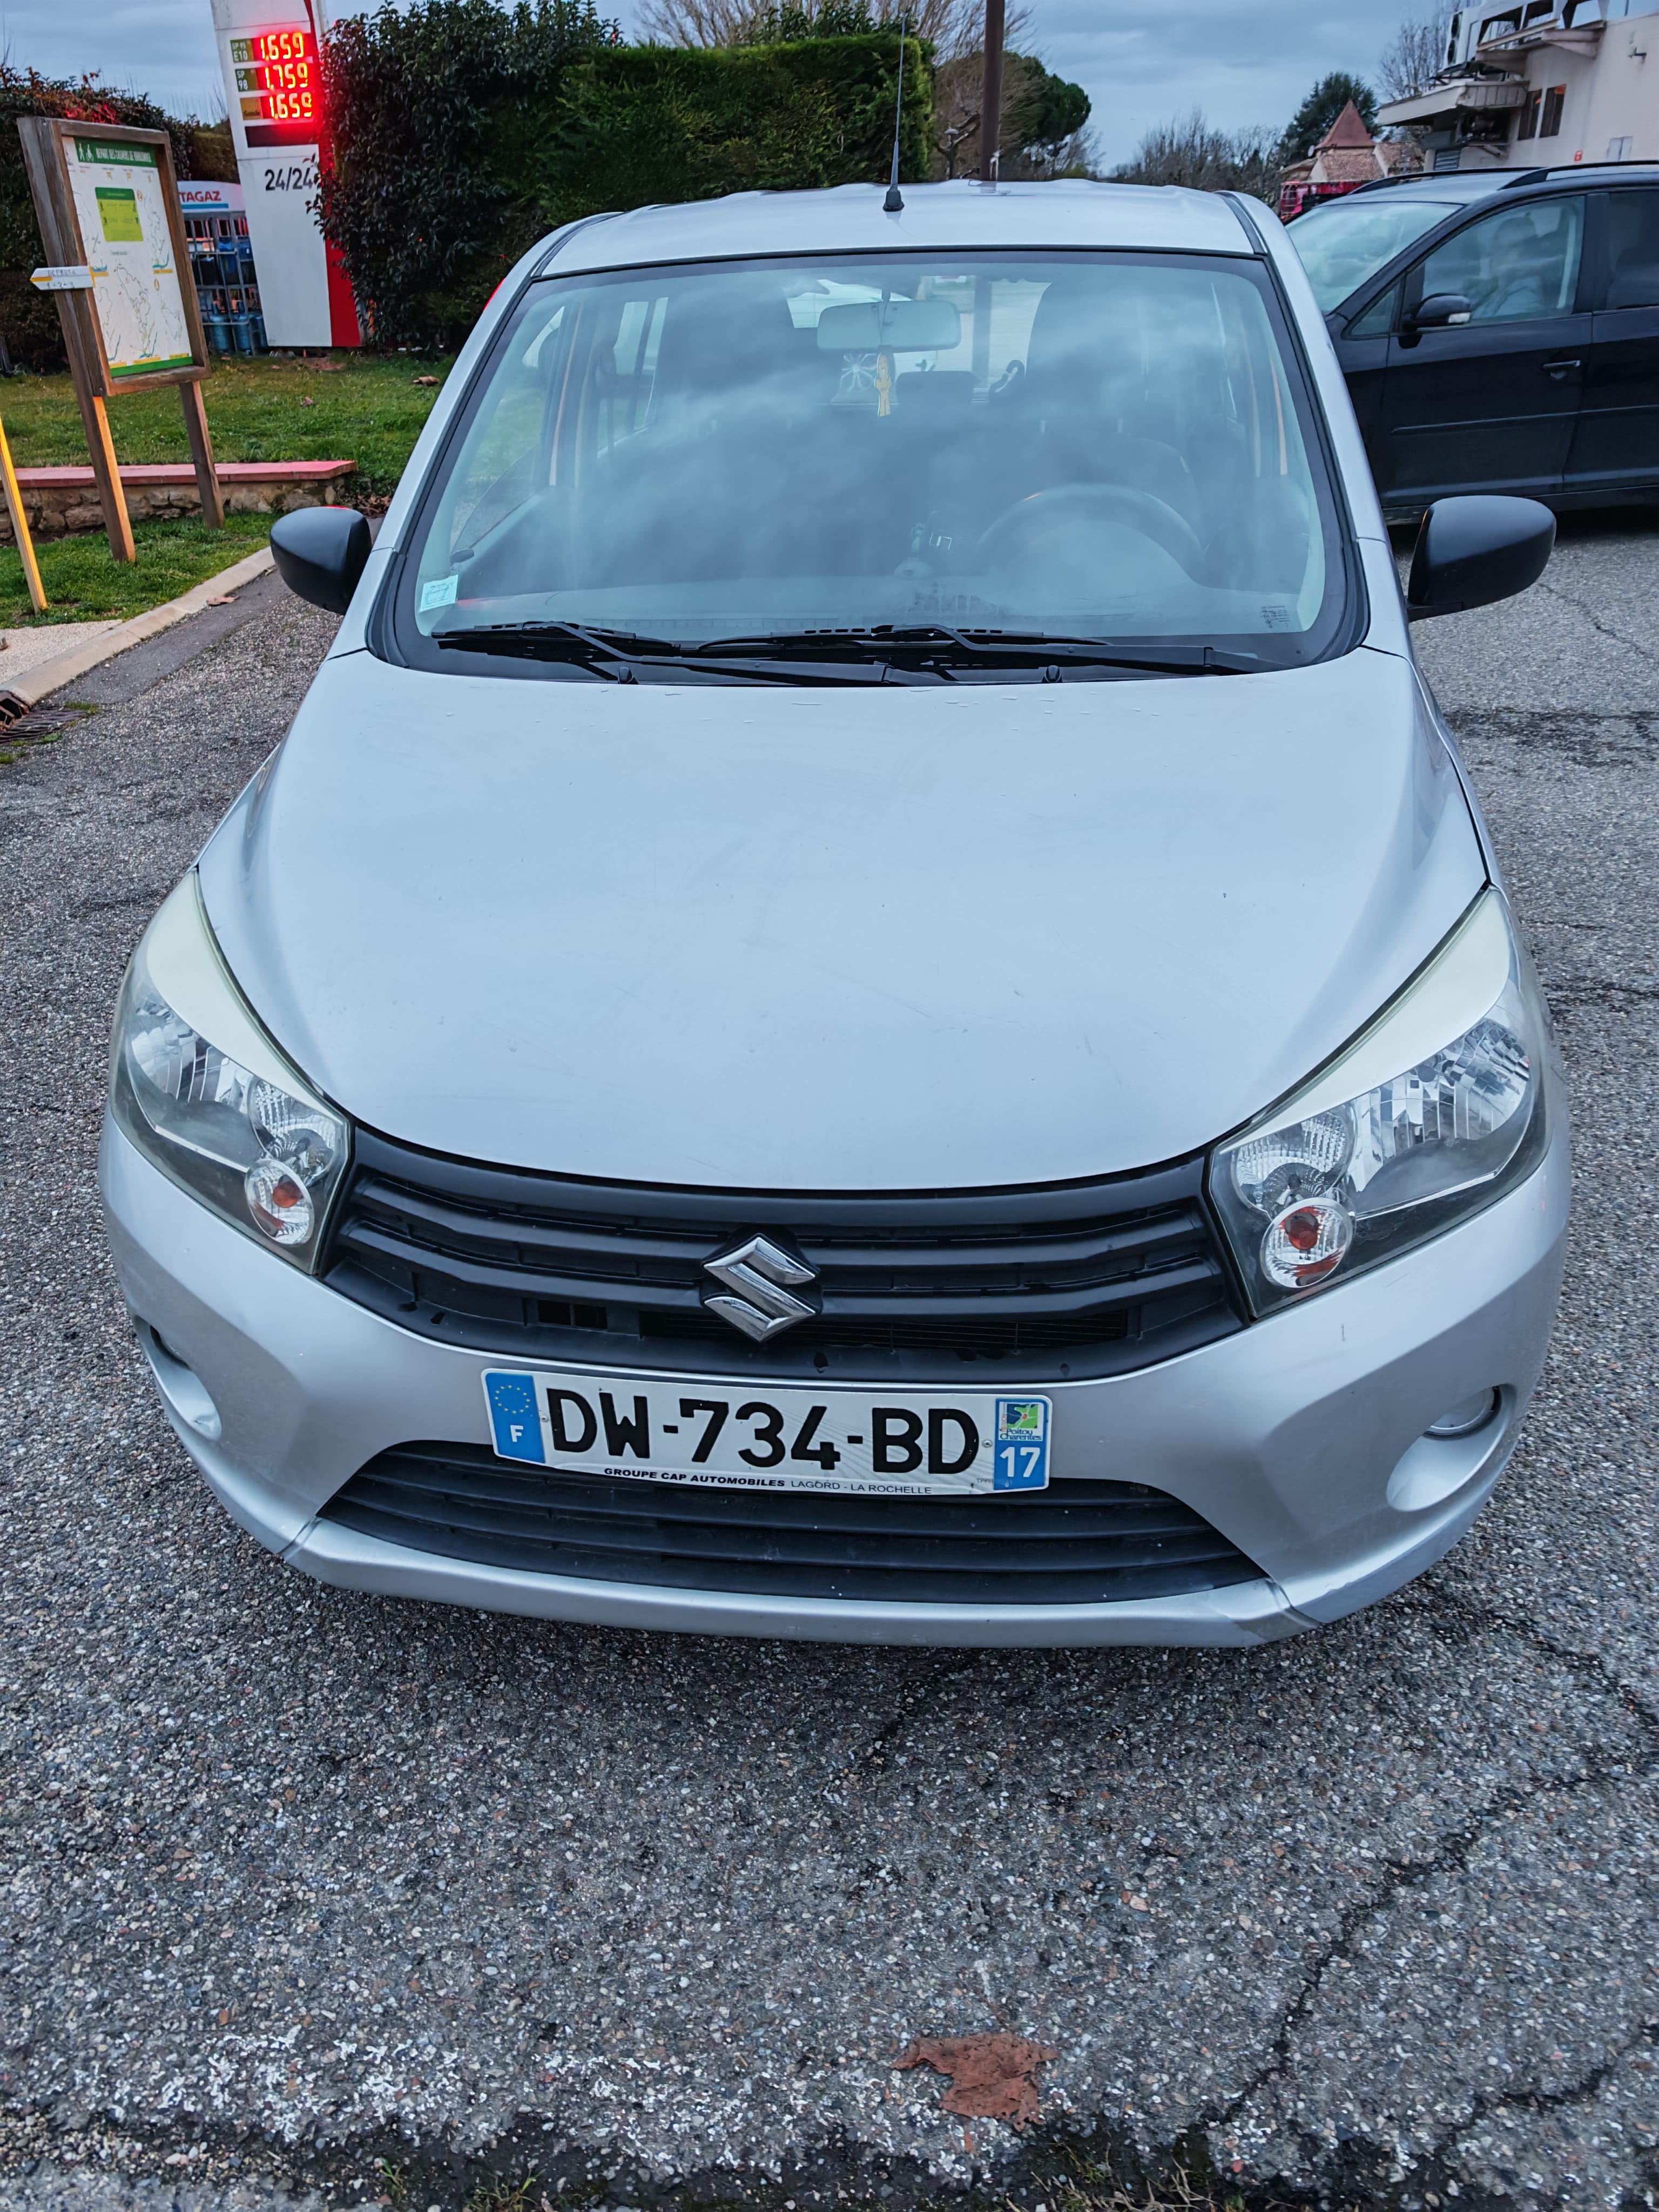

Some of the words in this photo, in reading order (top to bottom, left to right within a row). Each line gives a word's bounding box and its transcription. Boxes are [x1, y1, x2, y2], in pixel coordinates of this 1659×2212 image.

[233, 50, 248, 61] E10
[237, 70, 245, 79] SP
[238, 80, 248, 90] 98
[264, 167, 314, 191] 24/24
[179, 191, 221, 203] TAGAZ
[510, 1425, 524, 1442] F
[547, 1388, 979, 1474] DW-734-BD
[1000, 1447, 1040, 1478] 17
[604, 1468, 657, 1479] GROUPE
[661, 1473, 687, 1481] CAP
[691, 1475, 785, 1487] AUTOMOBILES
[791, 1480, 840, 1490] LAGORD
[851, 1483, 865, 1492] LA
[869, 1485, 932, 1494] ROCHELLE
